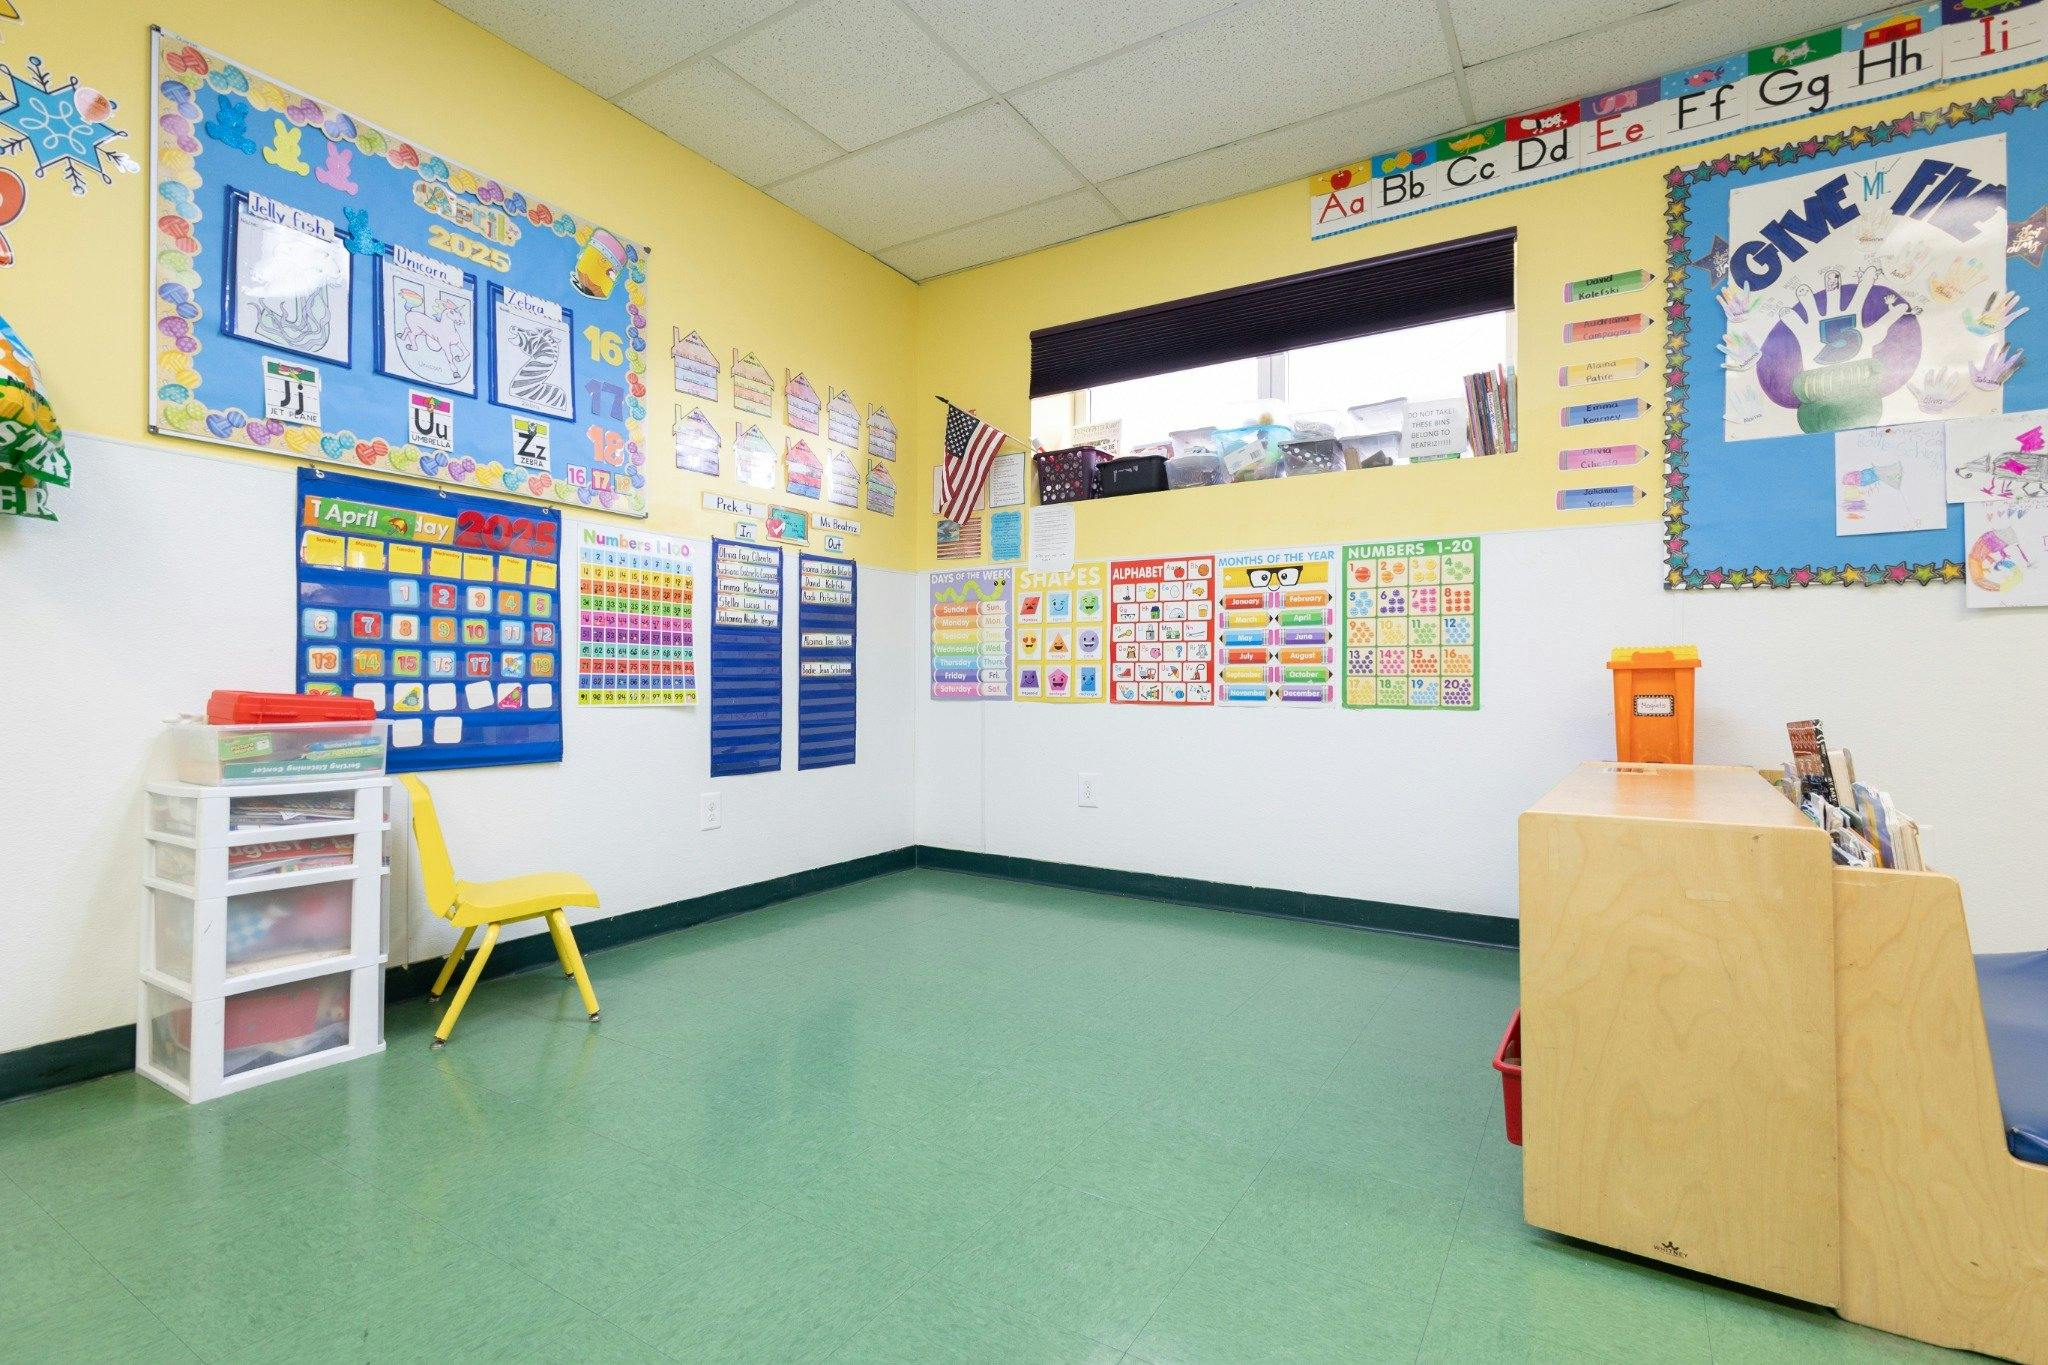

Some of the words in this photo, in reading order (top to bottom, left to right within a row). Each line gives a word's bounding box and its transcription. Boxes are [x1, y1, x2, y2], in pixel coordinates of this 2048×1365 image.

[1319, 192, 1365, 224] Aa
[1383, 171, 1425, 206] Bb
[1447, 155, 1495, 187] Cc
[1518, 129, 1568, 171] Dd
[1597, 113, 1645, 151] Ee
[1678, 84, 1735, 130] Ff
[1759, 68, 1830, 113] Gg
[1858, 39, 1922, 86] Hh
[1979, 16, 2009, 56] Ii
[251, 198, 286, 224] Jelly
[424, 188, 506, 241] April
[1730, 174, 1861, 292] GIVE
[1863, 171, 1891, 201] ME
[428, 225, 511, 273] 2025
[396, 248, 448, 280] Unicorn
[1586, 275, 1614, 286] David
[1578, 287, 1619, 300] Kolefski
[507, 291, 545, 315] Zebra
[1813, 313, 1863, 365] 5
[583, 325, 624, 367] 16
[1586, 361, 1617, 370] Alaina
[279, 380, 304, 416] Jj
[585, 378, 625, 422] 17
[1586, 402, 1619, 412] Emma
[270, 408, 284, 417] JET
[288, 410, 318, 423] PLANE
[1582, 414, 1621, 424] Kearney
[414, 408, 448, 440] Uu
[412, 434, 451, 449] UMBRELLA
[1411, 431, 1439, 439] BELONG
[518, 432, 547, 461] Zz
[520, 456, 544, 468] ZEBRA
[569, 467, 586, 485] 16
[593, 471, 610, 489] 17
[717, 497, 738, 513] Prek
[746, 504, 753, 516] 4
[325, 503, 378, 528] April
[455, 510, 557, 557] 2025
[741, 525, 751, 538] In
[833, 517, 858, 533] Beatriz
[315, 536, 338, 545] Sunday
[355, 540, 378, 549] Monday
[395, 545, 417, 555] Tuesday
[433, 549, 460, 560] Wednesday
[583, 528, 651, 552] Numbers
[656, 540, 691, 558] 1-100
[828, 538, 842, 550] Out
[1348, 543, 1425, 560] NUMBERS
[1435, 540, 1473, 554] 1-20
[1218, 555, 1264, 567] MONTHS
[1267, 554, 1280, 564] OF
[1285, 552, 1304, 563] THE
[1308, 550, 1335, 560] YEAR
[1350, 563, 1355, 572] 1
[1380, 561, 1387, 571] 2
[1445, 557, 1453, 567] 4
[931, 573, 955, 585] DAYS
[956, 572, 966, 581] OF
[967, 571, 981, 579] THE
[983, 570, 1012, 581] WEEK
[1020, 566, 1101, 590] SHAPES
[1112, 566, 1163, 580] ALPHABET
[400, 584, 410, 602] 1
[438, 588, 450, 606] 2
[475, 592, 486, 608] 3
[505, 596, 517, 610] 4
[536, 598, 546, 612] 5
[1289, 594, 1322, 603] February
[1349, 592, 1356, 601] 5
[1380, 590, 1387, 600] 6
[1411, 589, 1418, 598] 7
[1444, 588, 1452, 597] 8
[1232, 598, 1260, 606] January
[943, 606, 968, 614] Sunday
[942, 619, 970, 628] Monday
[1293, 613, 1312, 622] April
[1349, 621, 1357, 630] 9
[1411, 619, 1421, 628] 11
[1444, 618, 1456, 628] 12
[312, 615, 328, 633] 6
[361, 616, 375, 634] 7
[400, 619, 412, 636] 8
[438, 623, 452, 638] 9
[466, 623, 486, 640] 10
[504, 625, 521, 640] 11
[534, 627, 553, 642] 12
[1237, 634, 1253, 643] May
[1294, 633, 1313, 641] June
[936, 645, 976, 654] Wednesday
[1349, 651, 1361, 660] 13
[1380, 650, 1392, 659] 14
[1411, 649, 1423, 659] 15
[1444, 649, 1457, 658] 16
[311, 651, 338, 671] 13
[357, 653, 381, 671] 14
[397, 655, 417, 672] 15
[432, 656, 452, 673] 16
[469, 656, 491, 673] 17
[533, 657, 552, 673] 19
[940, 658, 972, 667] Thursday
[1239, 653, 1254, 662] July
[1289, 652, 1316, 661] August
[945, 671, 967, 680] Friday
[989, 671, 1000, 679] Fri.
[1226, 670, 1263, 679] September
[1289, 670, 1319, 679] October
[940, 685, 972, 694] Saturday
[1379, 679, 1392, 689] 18
[1411, 679, 1424, 689] 19
[1444, 679, 1460, 689] 20
[1230, 689, 1265, 697] November
[1283, 689, 1320, 697] December
[252, 766, 284, 774] Center
[330, 762, 361, 771] Sorting
